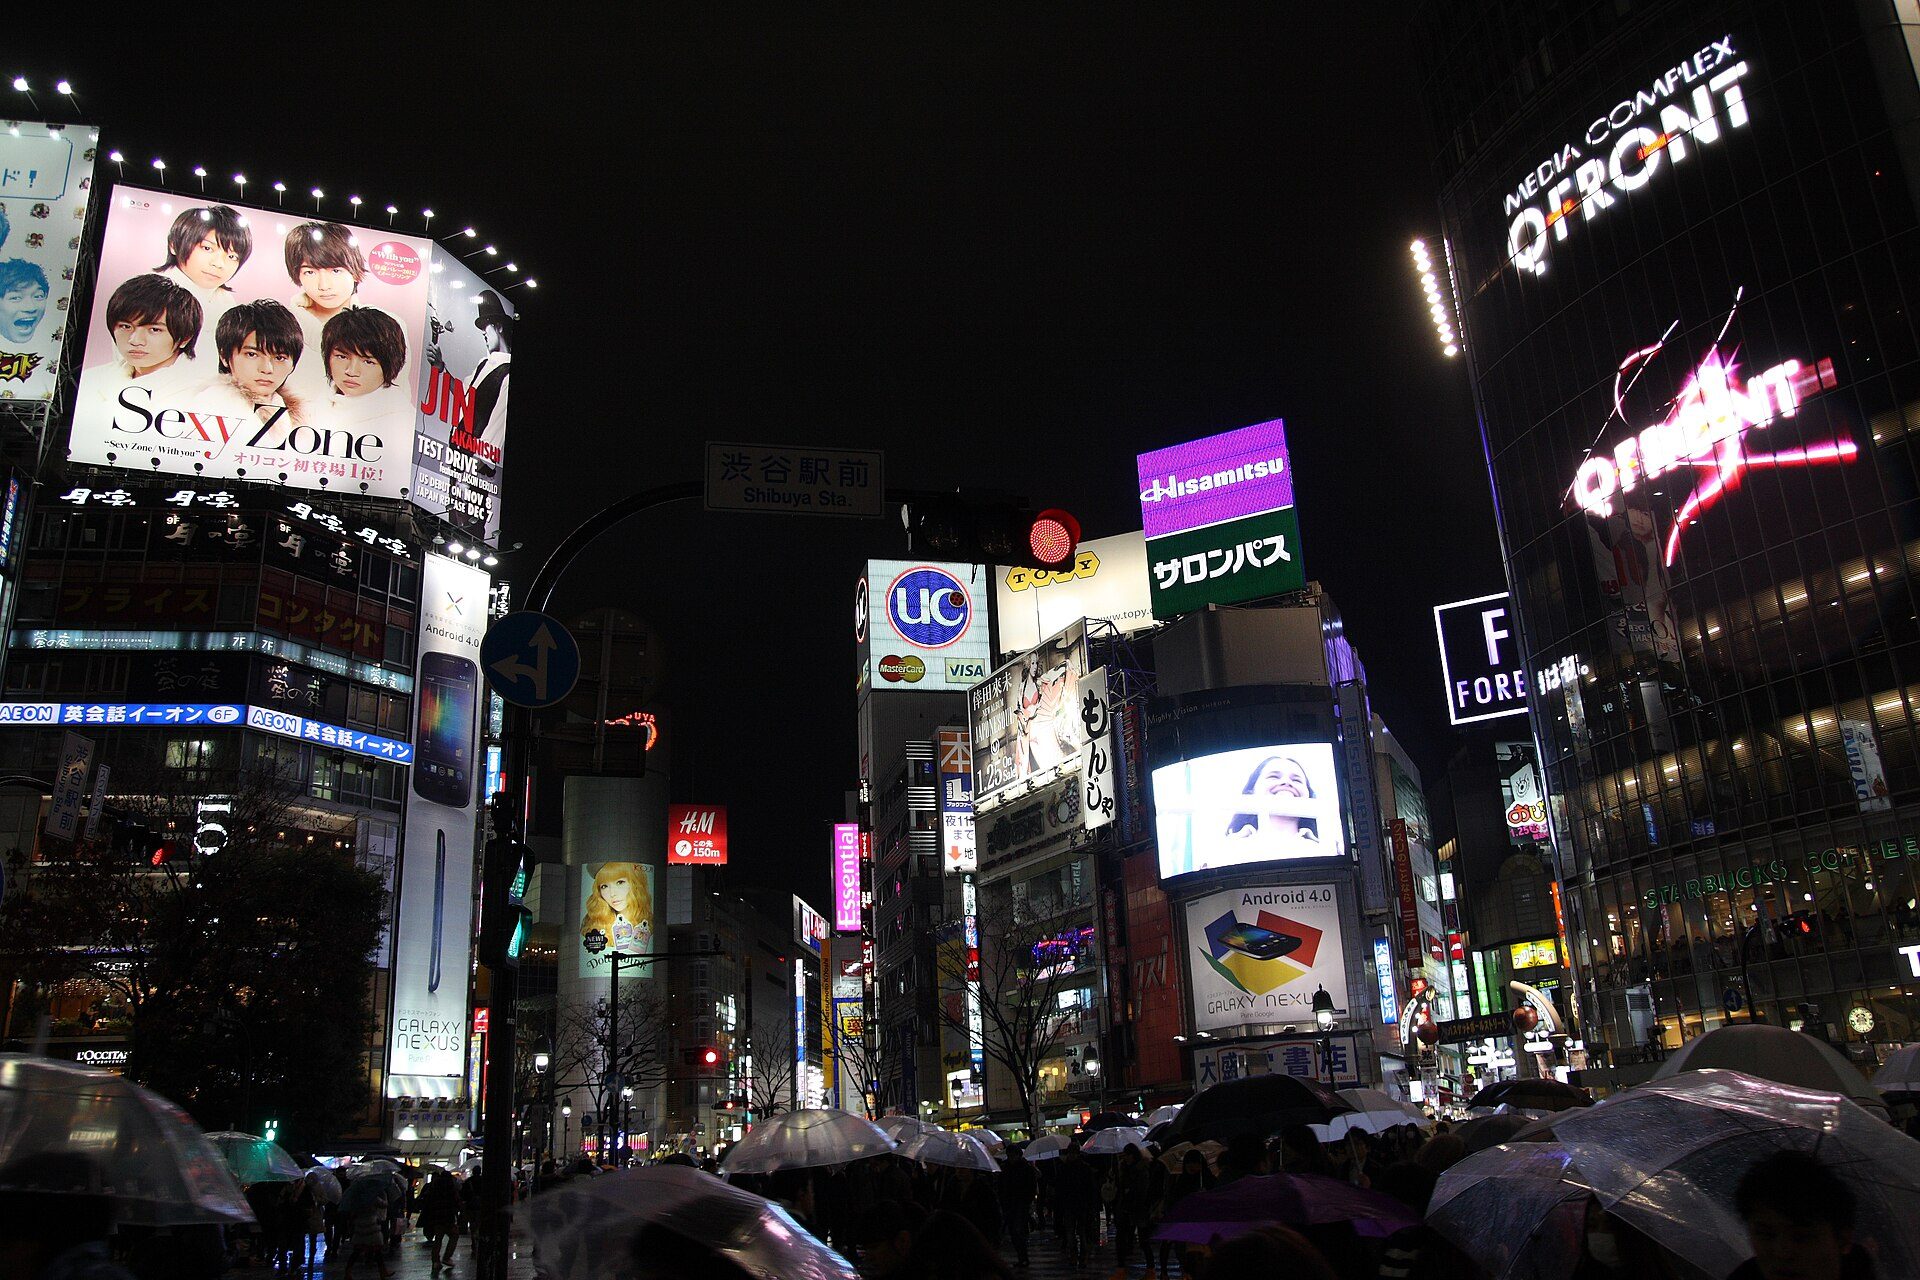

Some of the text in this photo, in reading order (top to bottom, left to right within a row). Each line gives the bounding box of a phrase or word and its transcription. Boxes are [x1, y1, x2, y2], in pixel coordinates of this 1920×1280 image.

[1503, 33, 1736, 217] MEDIA COMPLEX
[1506, 60, 1749, 276] QFRONT
[420, 365, 477, 435] JIN
[112, 386, 384, 463] Sexy Zone
[417, 434, 478, 477] TEST DRIVE
[451, 430, 501, 464] AKANISHI
[721, 453, 869, 488] 渋谷駅前
[416, 485, 440, 505] JAPAN
[467, 504, 485, 521] DEC
[485, 511, 494, 524] 7
[419, 472, 493, 511] US DEBUT ON NOV 8
[744, 487, 852, 507] Shibuya Sta.
[166, 515, 180, 525] 9F
[279, 523, 292, 533] 9F
[1013, 559, 1093, 584] TOY
[1153, 534, 1291, 590] サロンパス
[63, 585, 210, 616] プライス
[260, 591, 380, 648] コンタクト
[425, 623, 464, 643] Android
[465, 636, 480, 648] 4.0
[1481, 607, 1509, 666] F
[232, 635, 247, 647] 7F
[260, 638, 274, 650] 7F
[880, 663, 924, 674] MasterCard
[950, 664, 984, 677] VISA
[0, 705, 233, 723] AEON 英会話イーオン 6F
[252, 710, 411, 760] AEON 英会話イーオン
[940, 732, 971, 774] 本
[1081, 689, 1114, 819] もんじゃ
[977, 760, 1002, 794] 1.25
[680, 811, 715, 835] H&M
[693, 839, 713, 848] この先
[693, 848, 720, 858] 150m
[837, 826, 857, 928] Essential
[1646, 860, 1789, 909] STARBUCKS
[1241, 888, 1332, 907] Android 4.0
[1207, 994, 1257, 1014] GALAXY
[1265, 993, 1315, 1008] NEXU
[397, 1018, 461, 1035] GALAXY
[397, 1033, 460, 1052] NEXUS
[1200, 1043, 1349, 1085] 大盛書店
